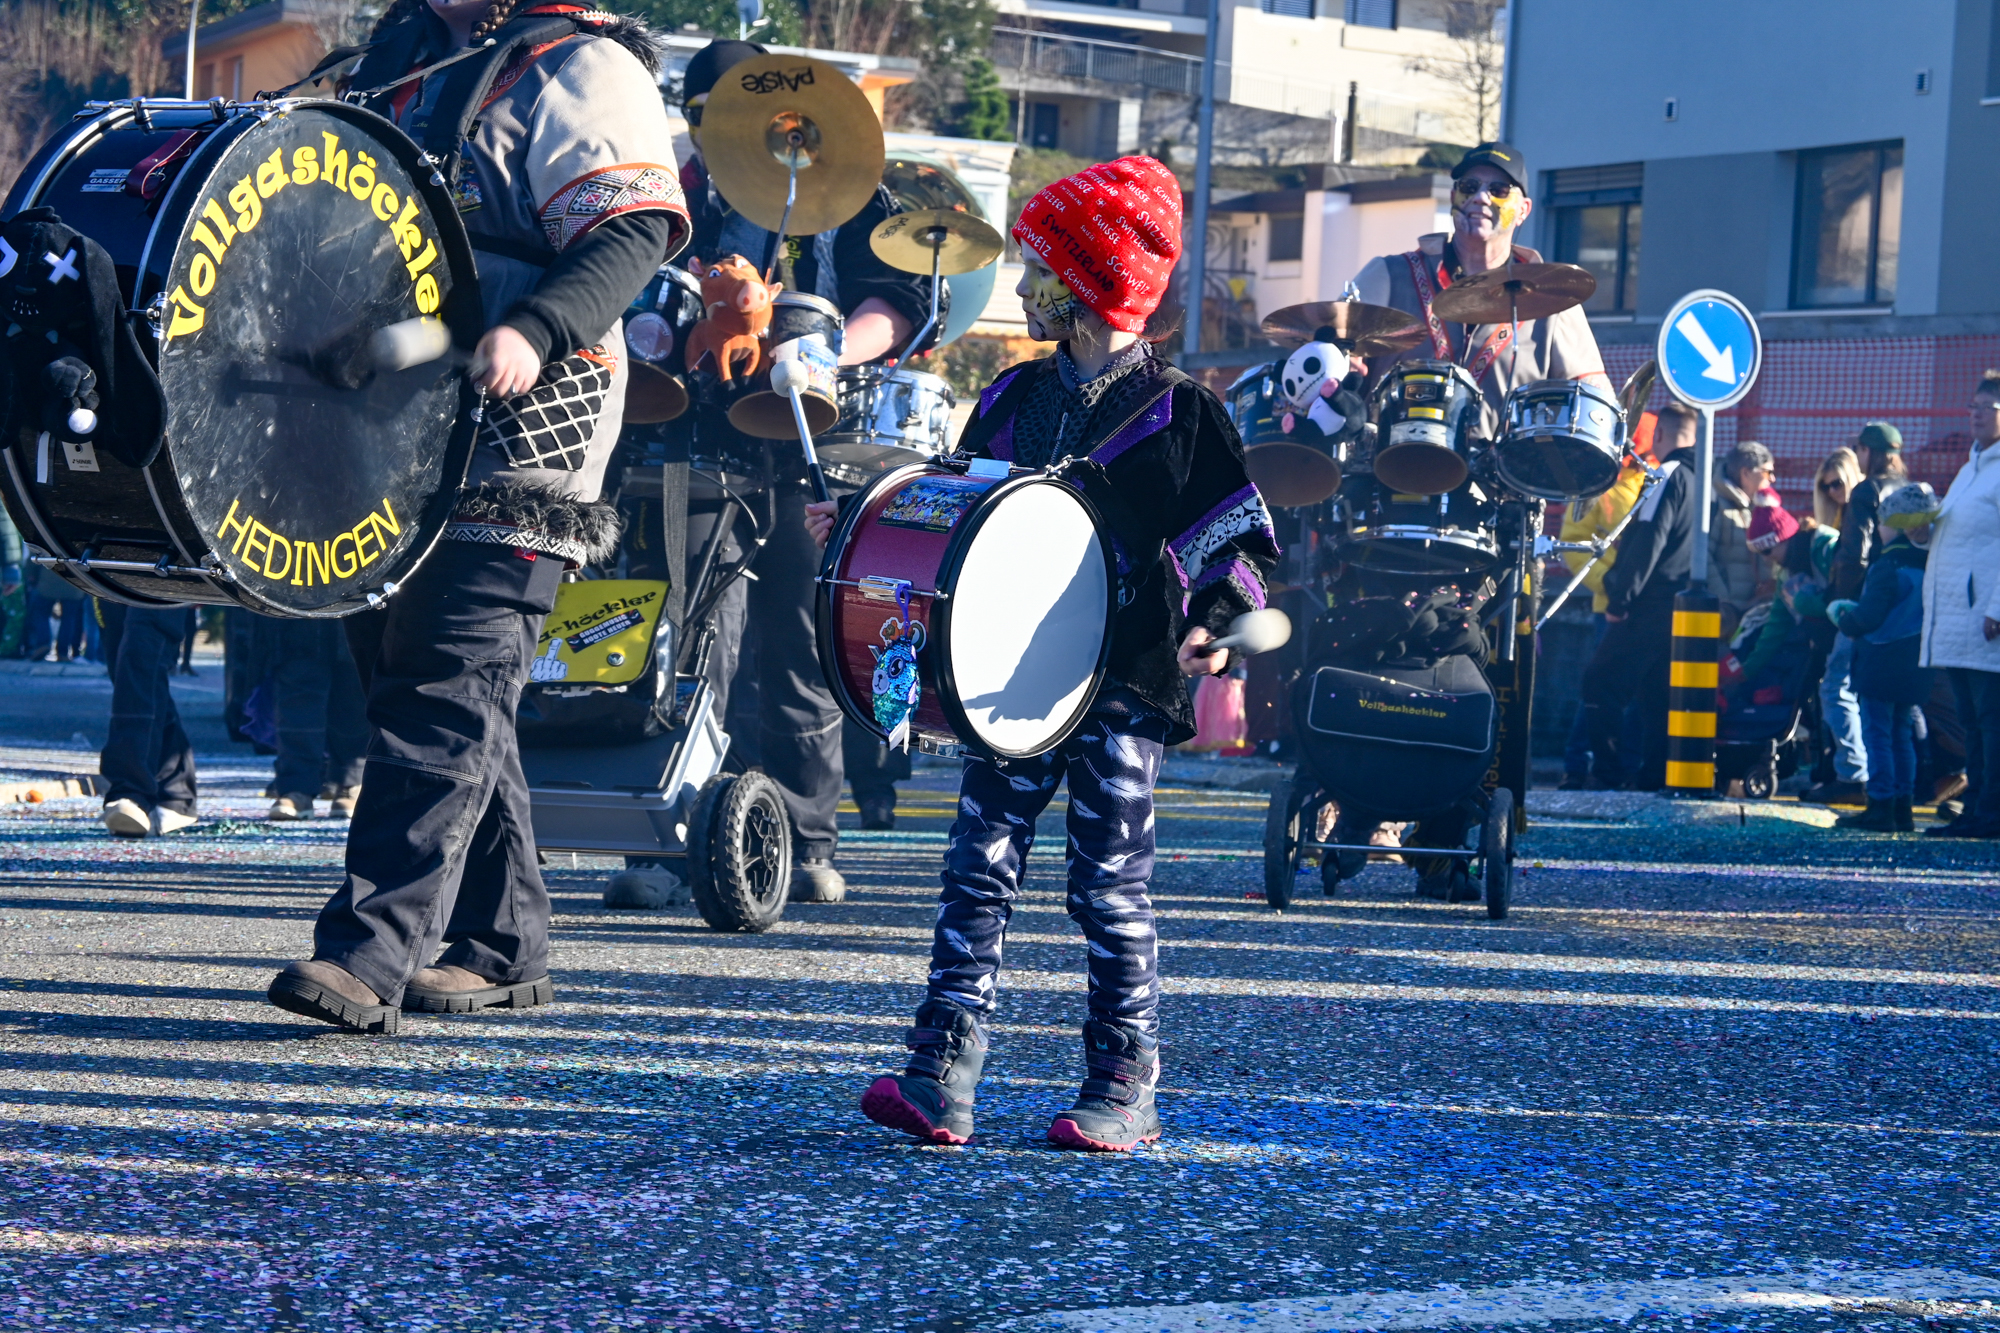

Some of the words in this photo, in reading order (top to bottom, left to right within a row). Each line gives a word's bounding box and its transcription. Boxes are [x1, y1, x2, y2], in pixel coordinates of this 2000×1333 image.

[1124, 180, 1151, 204] SUISSE
[166, 130, 446, 345] Vollgashöckle
[1092, 214, 1121, 245] SUISSE
[1115, 215, 1160, 263] SWITZERLAND
[1041, 213, 1114, 292] SWITZERLAND
[1063, 267, 1099, 304] SCHWEIZ
[1106, 255, 1150, 295] SCHWEIZ
[216, 497, 401, 586] HEDINGEN
[579, 614, 628, 638] GUGGEMUSIG
